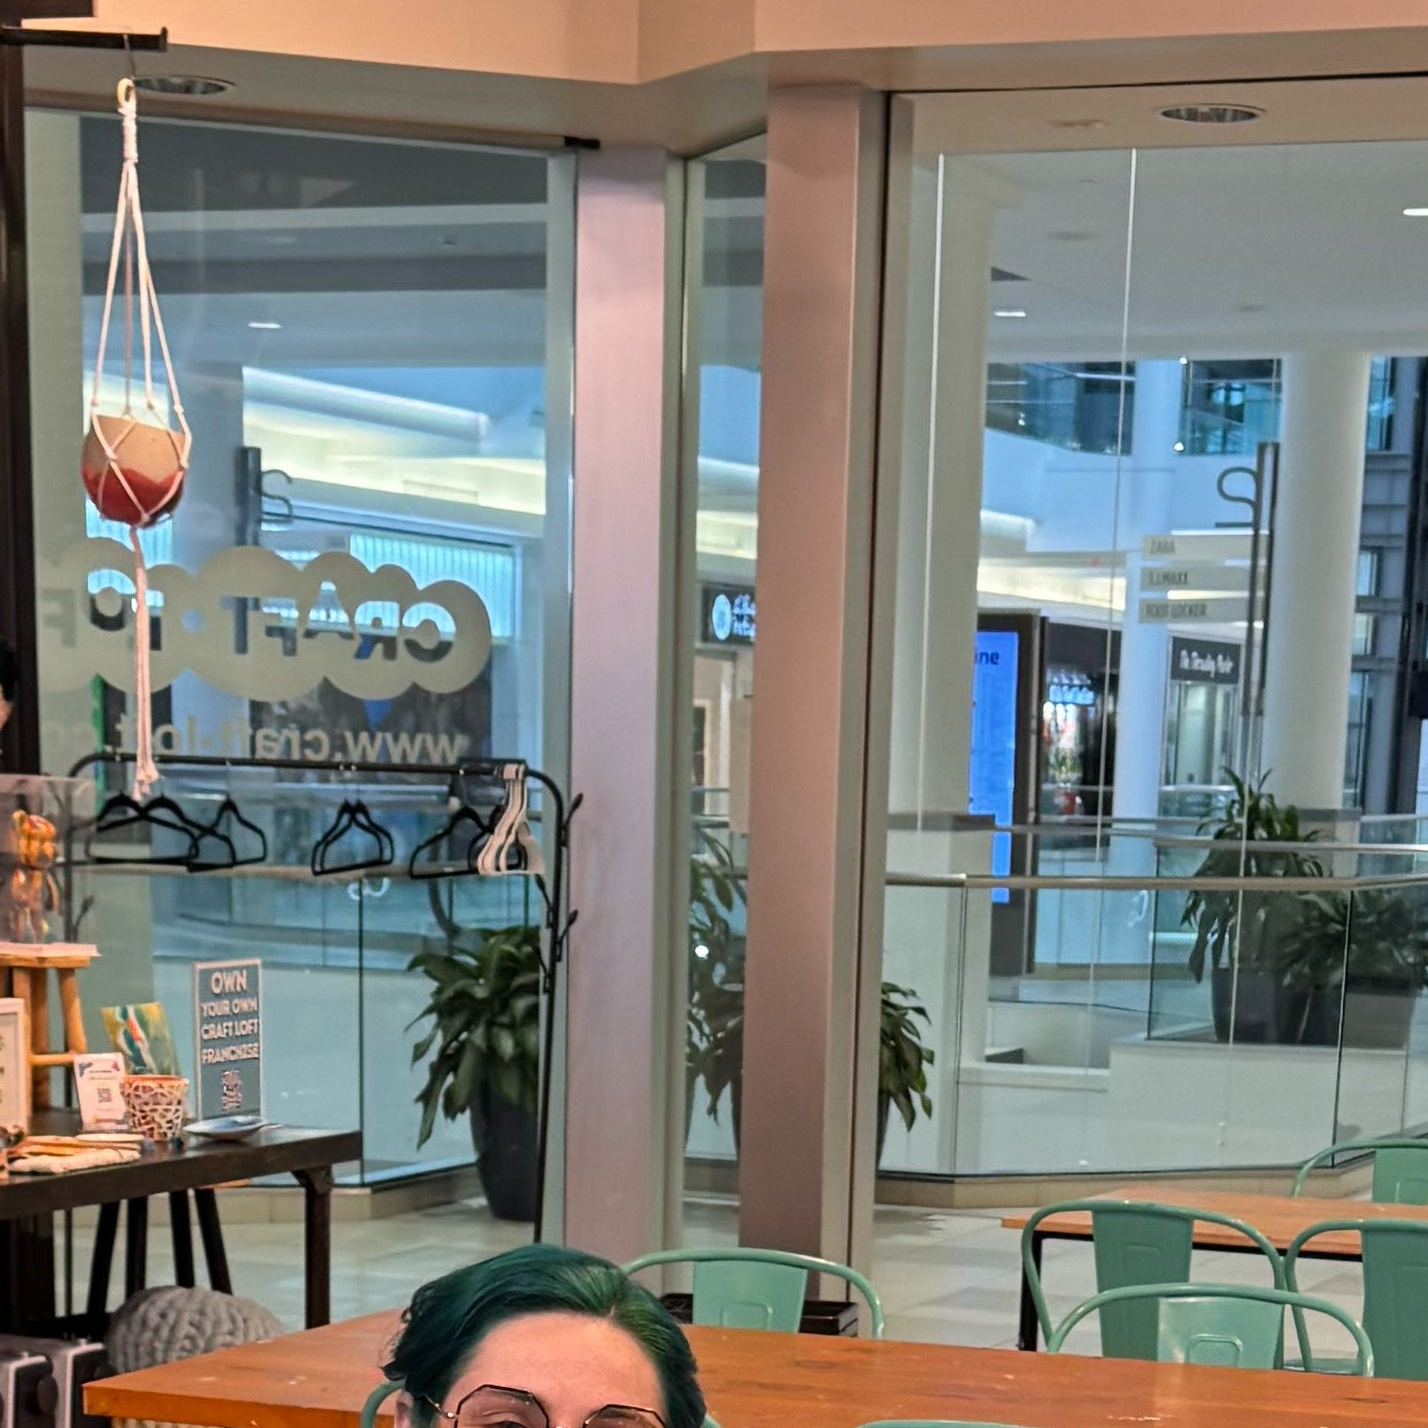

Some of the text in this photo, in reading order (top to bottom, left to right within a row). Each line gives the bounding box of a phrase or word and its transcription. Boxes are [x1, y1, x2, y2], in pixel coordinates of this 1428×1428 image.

[1171, 603, 1207, 618] LOCKER
[210, 969, 247, 994] OWN
[201, 998, 258, 1018] YOUR OWN
[201, 1019, 258, 1040] CRAFT LOFT
[202, 1043, 259, 1064] FRANCHISE
